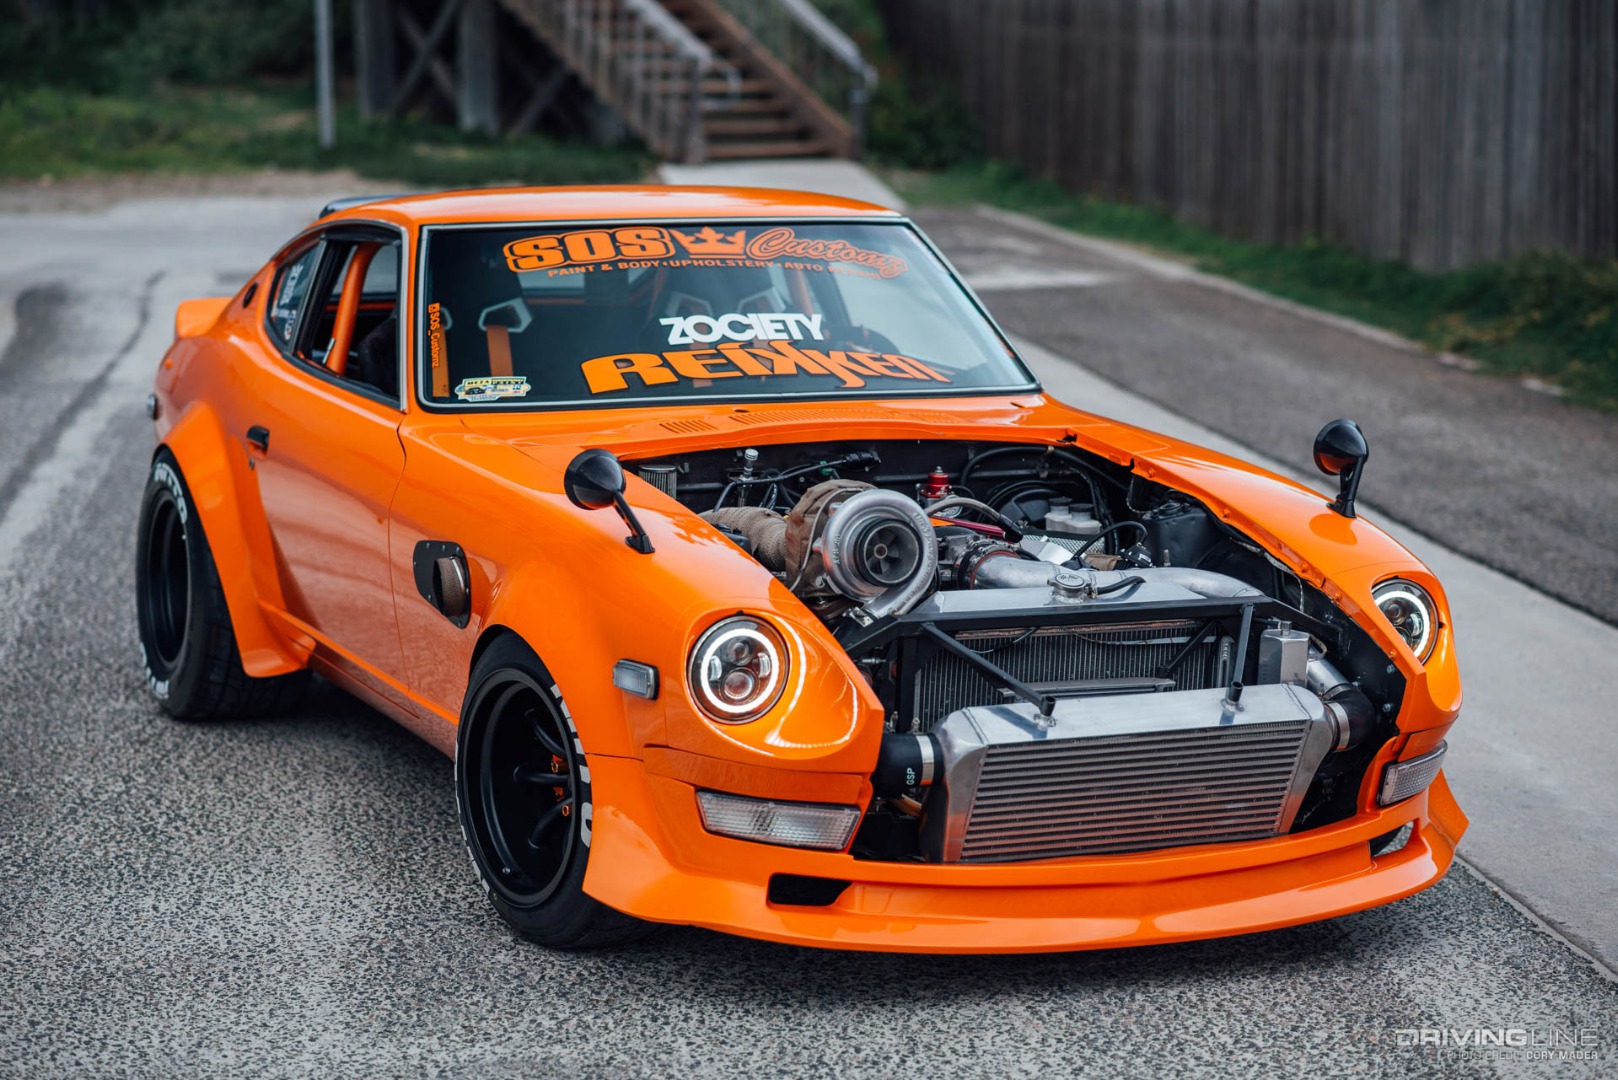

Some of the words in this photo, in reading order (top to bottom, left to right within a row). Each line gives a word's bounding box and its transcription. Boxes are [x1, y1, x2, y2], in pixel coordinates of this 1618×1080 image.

[503, 226, 676, 272] SOS
[746, 227, 908, 279] Customz
[548, 264, 595, 278] PAINT
[601, 263, 614, 271] &
[618, 260, 660, 269] BODY
[669, 258, 774, 269] UPHOLSTERY
[785, 261, 823, 272] AUTO
[659, 312, 824, 346] ZOCIETY
[906, 768, 915, 785] GSP
